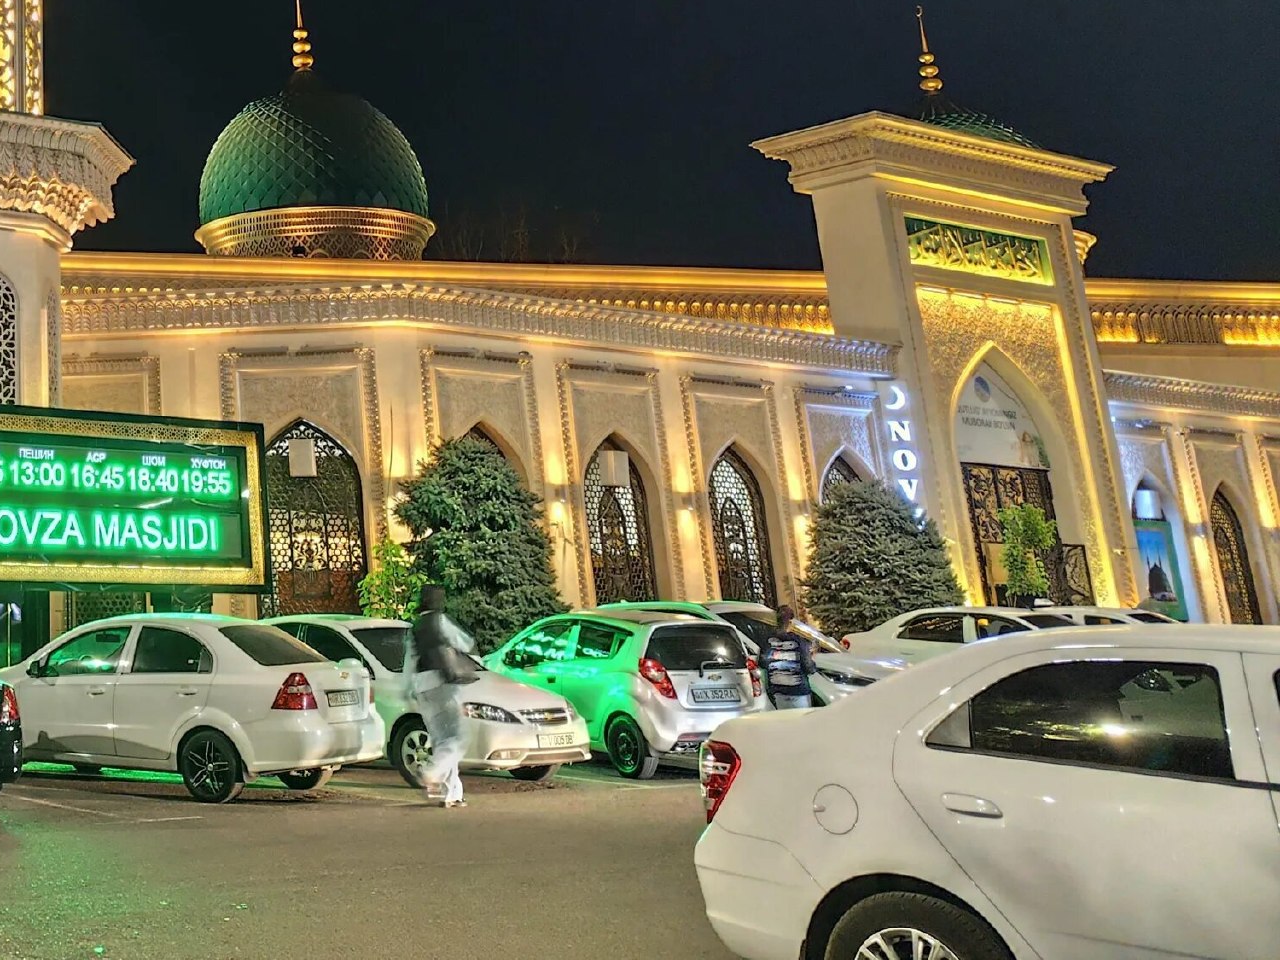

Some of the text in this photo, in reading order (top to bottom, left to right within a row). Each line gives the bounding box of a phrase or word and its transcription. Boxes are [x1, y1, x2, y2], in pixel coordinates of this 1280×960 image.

[19, 448, 55, 460] ПЕШИН
[142, 455, 166, 467] ШОМ
[190, 458, 226, 470] ХУФТОН
[10, 461, 65, 486] 13:00
[71, 464, 124, 489] 16:45
[128, 468, 179, 491] 18:40
[181, 470, 231, 494] 19:55
[94, 513, 218, 551] MASJIDI
